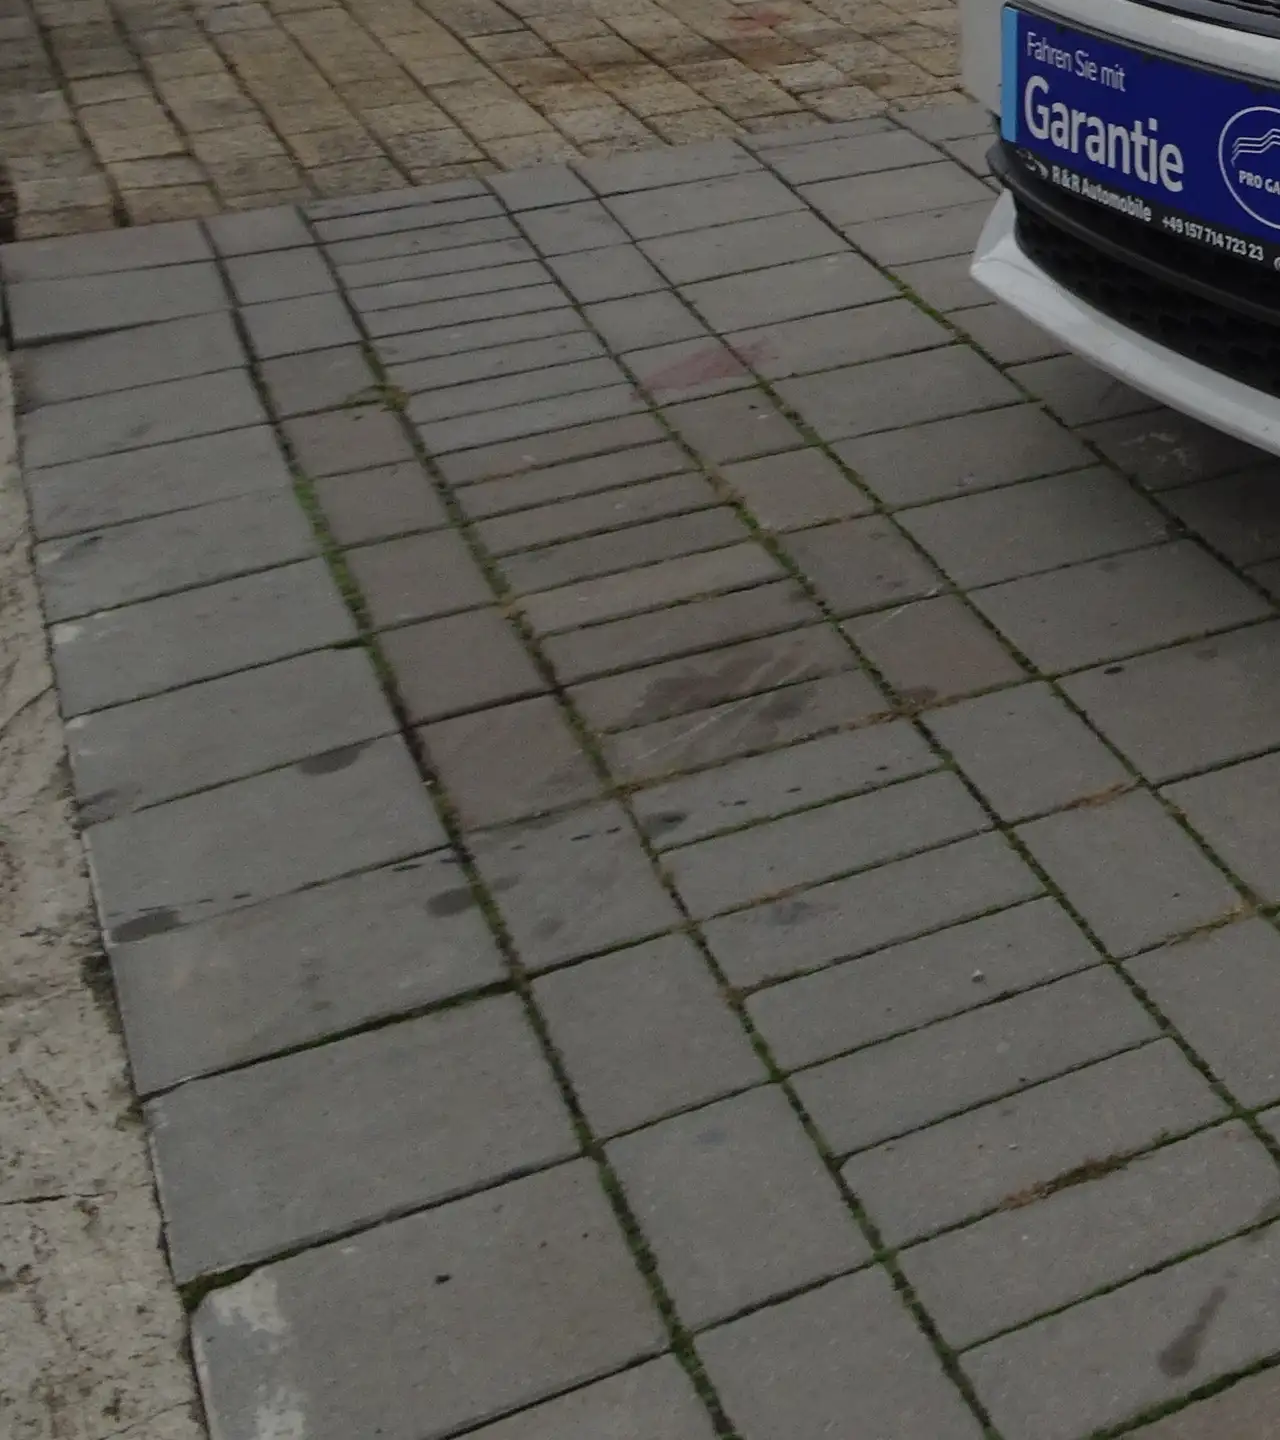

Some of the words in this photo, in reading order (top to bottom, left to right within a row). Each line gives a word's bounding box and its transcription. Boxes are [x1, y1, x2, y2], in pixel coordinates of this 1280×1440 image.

[1026, 31, 1072, 72] Fahren
[1074, 50, 1098, 81] Sie
[1101, 64, 1126, 92] mit
[1024, 75, 1184, 193] Garantie
[1239, 170, 1263, 189] PRO
[1082, 178, 1152, 222] Automobile
[1162, 217, 1183, 234] +49
[1185, 221, 1203, 240] 157
[1205, 228, 1224, 248] 714
[1225, 235, 1247, 255] 723
[1248, 244, 1264, 261] 23
